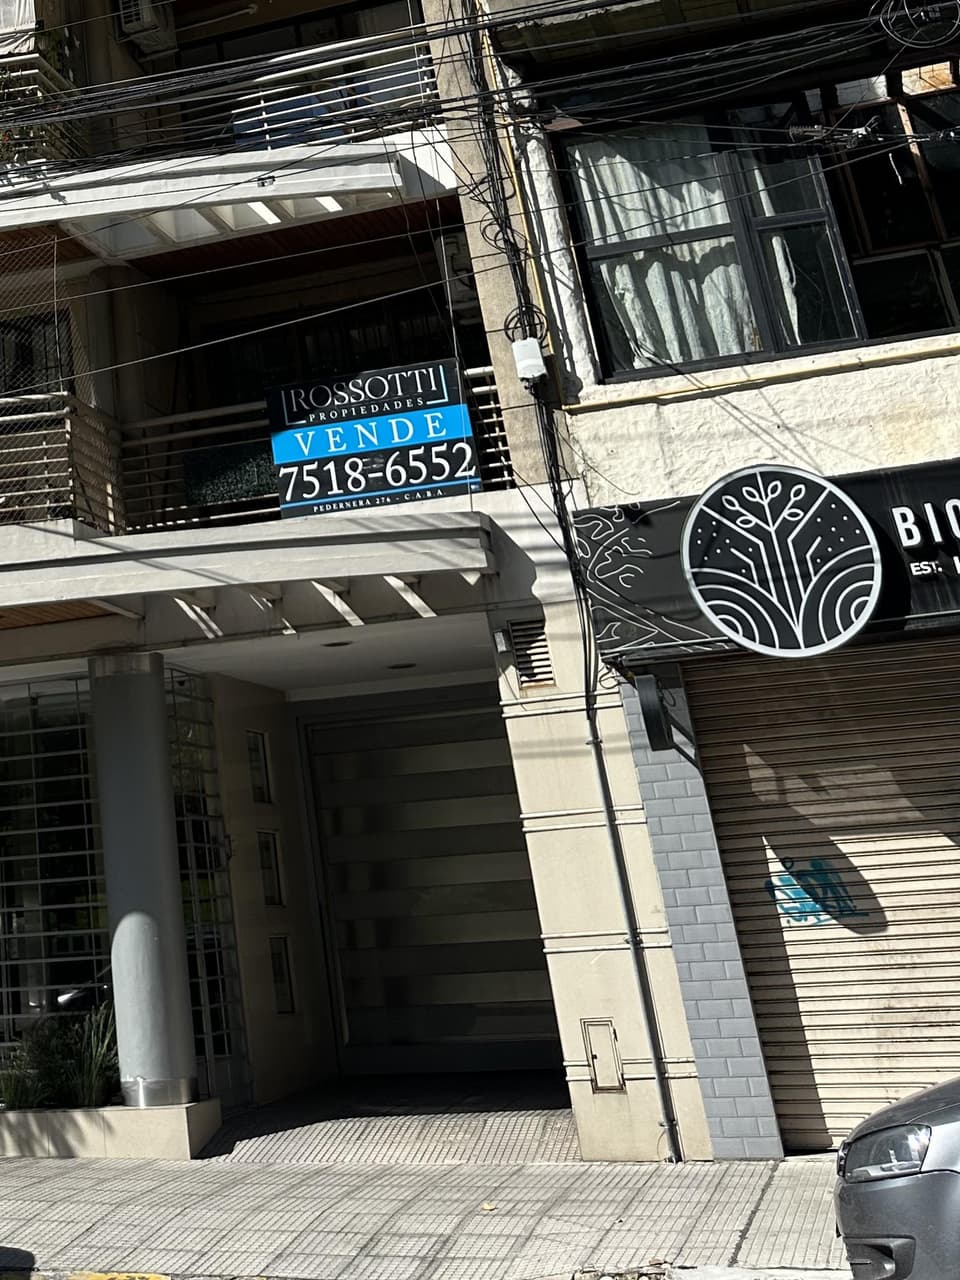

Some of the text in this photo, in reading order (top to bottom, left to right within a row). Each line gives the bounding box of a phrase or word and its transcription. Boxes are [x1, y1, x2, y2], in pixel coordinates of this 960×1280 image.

[290, 367, 437, 412] ROSSOTTI
[309, 397, 424, 422] PROPIEDADES
[295, 412, 447, 457] VENDE
[279, 441, 476, 502] 7518-6552
[313, 499, 371, 513] PEDERNERA
[910, 560, 943, 576] EST.
